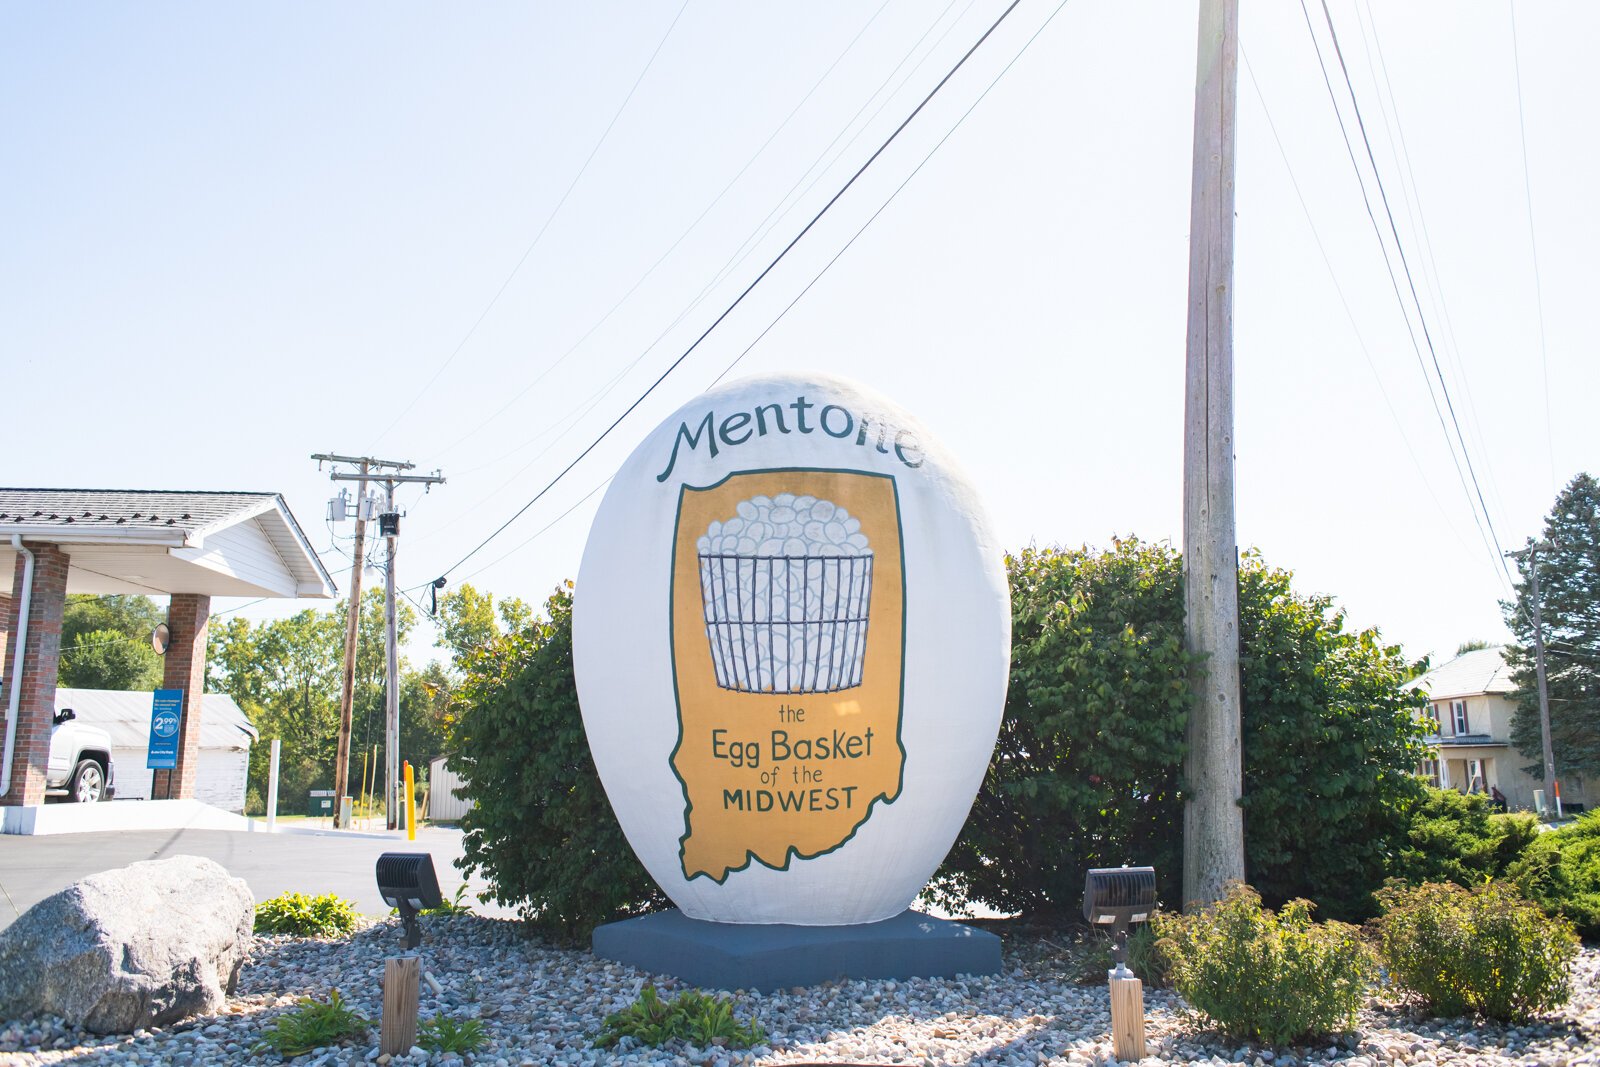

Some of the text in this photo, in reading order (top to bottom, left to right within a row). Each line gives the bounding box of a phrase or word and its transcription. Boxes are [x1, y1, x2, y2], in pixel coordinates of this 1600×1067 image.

[657, 396, 925, 483] Mentone
[778, 704, 805, 723] the
[712, 727, 874, 769] Egg Basket
[760, 765, 823, 787] of the
[723, 786, 858, 812] MIDWEST
